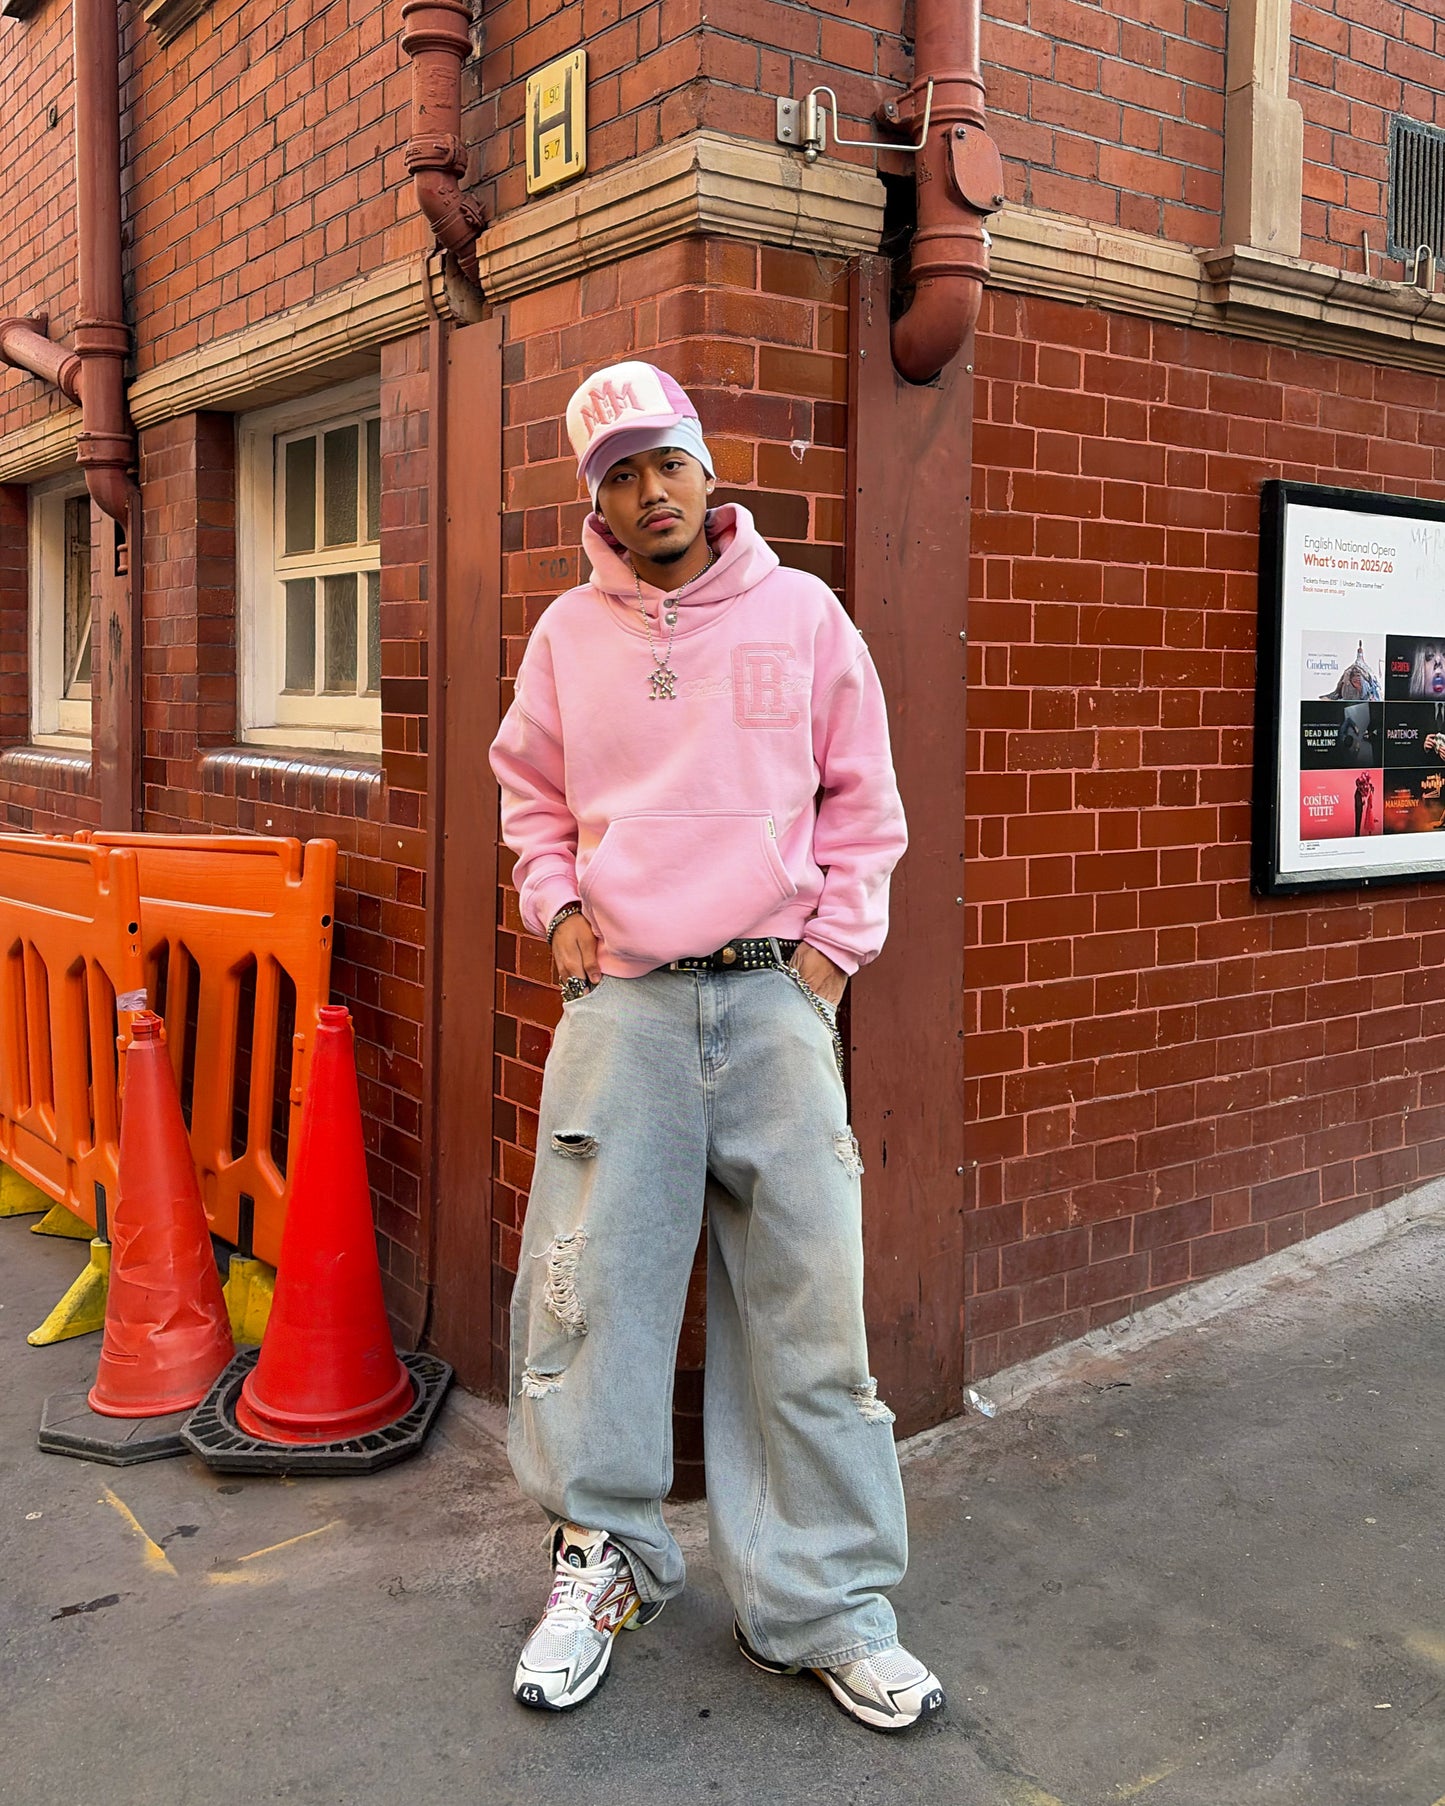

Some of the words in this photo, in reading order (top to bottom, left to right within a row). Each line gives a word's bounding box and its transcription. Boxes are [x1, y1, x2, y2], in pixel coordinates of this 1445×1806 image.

[533, 66, 573, 179] H
[1304, 535, 1333, 552] English
[1334, 539, 1370, 554] National
[1371, 542, 1396, 558] Opera
[1303, 552, 1336, 569] What's
[1338, 559, 1349, 569] on
[1350, 557, 1359, 570] in
[1360, 558, 1394, 573] 2025/26
[1303, 576, 1318, 585] Tickets
[1306, 659, 1339, 670] Cinderella
[1304, 729, 1322, 738] DEAD
[1323, 729, 1339, 738] MAN
[1386, 729, 1419, 739] PARTENOPE
[1306, 738, 1337, 747] WALKING
[1309, 805, 1334, 817] TUTTE
[522, 1686, 538, 1702] 43
[929, 1692, 942, 1710] 43
